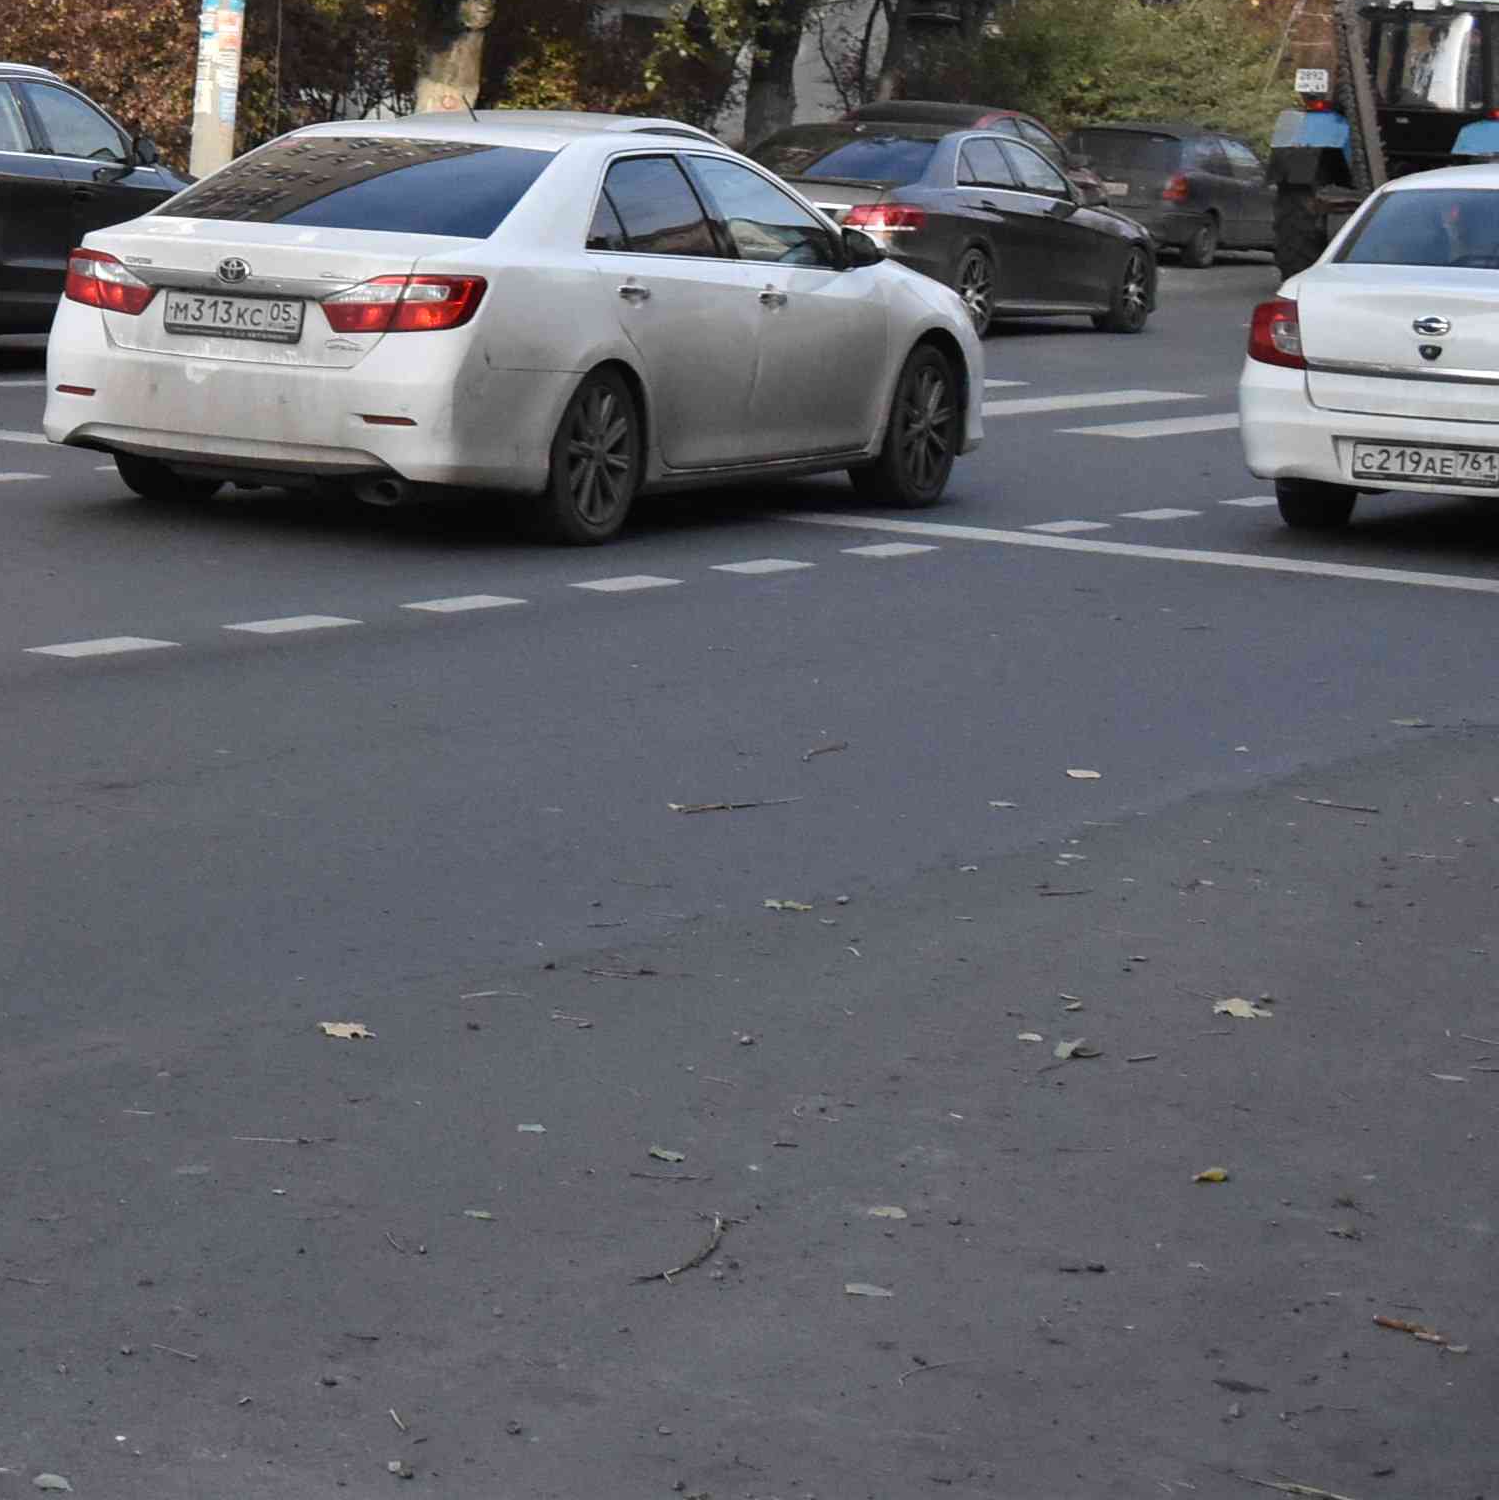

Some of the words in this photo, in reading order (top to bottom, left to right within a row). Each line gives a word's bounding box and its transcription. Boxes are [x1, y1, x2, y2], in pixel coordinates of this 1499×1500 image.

[172, 298, 264, 327] М313КС
[269, 303, 293, 322] 05
[1361, 449, 1454, 476] С219АЕ
